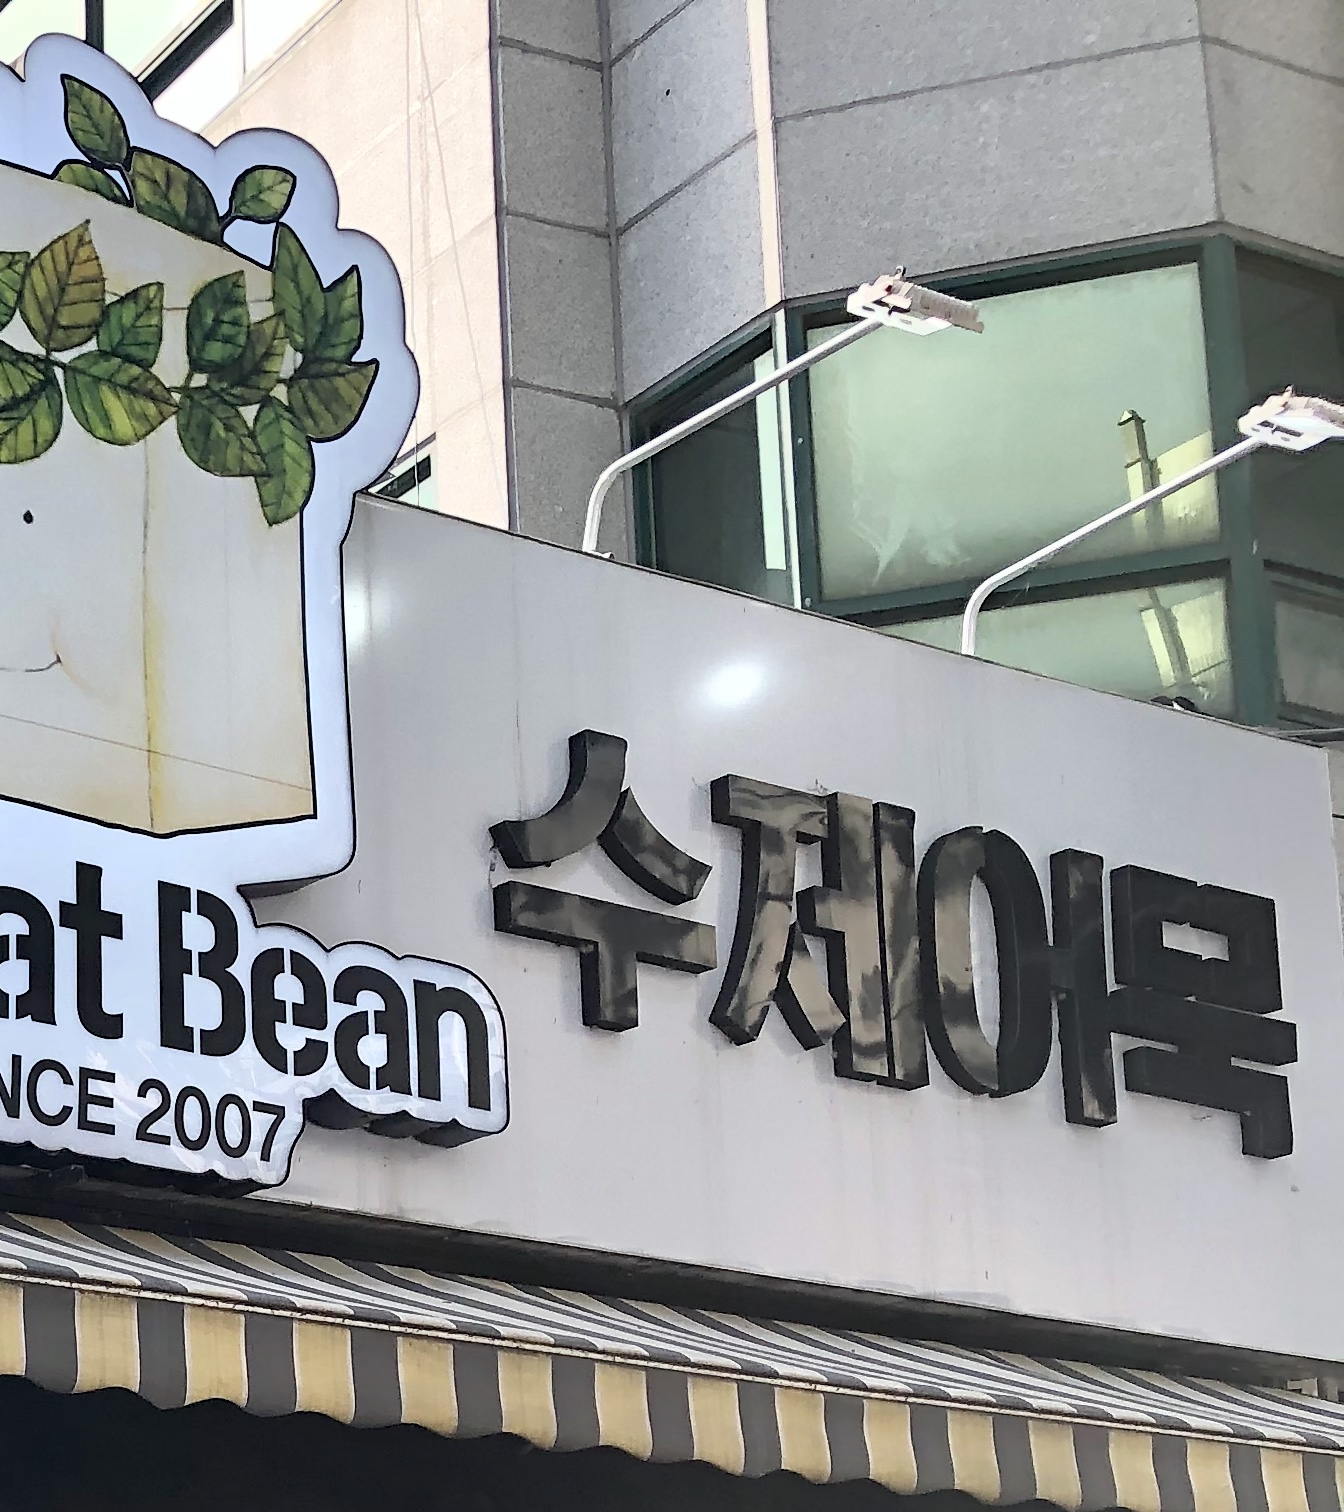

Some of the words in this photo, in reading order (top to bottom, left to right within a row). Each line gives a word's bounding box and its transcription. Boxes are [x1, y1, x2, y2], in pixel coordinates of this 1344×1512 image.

[158, 882, 491, 1111] Bean
[490, 728, 1300, 1159] 수제어묵
[137, 1077, 288, 1163] 2007
